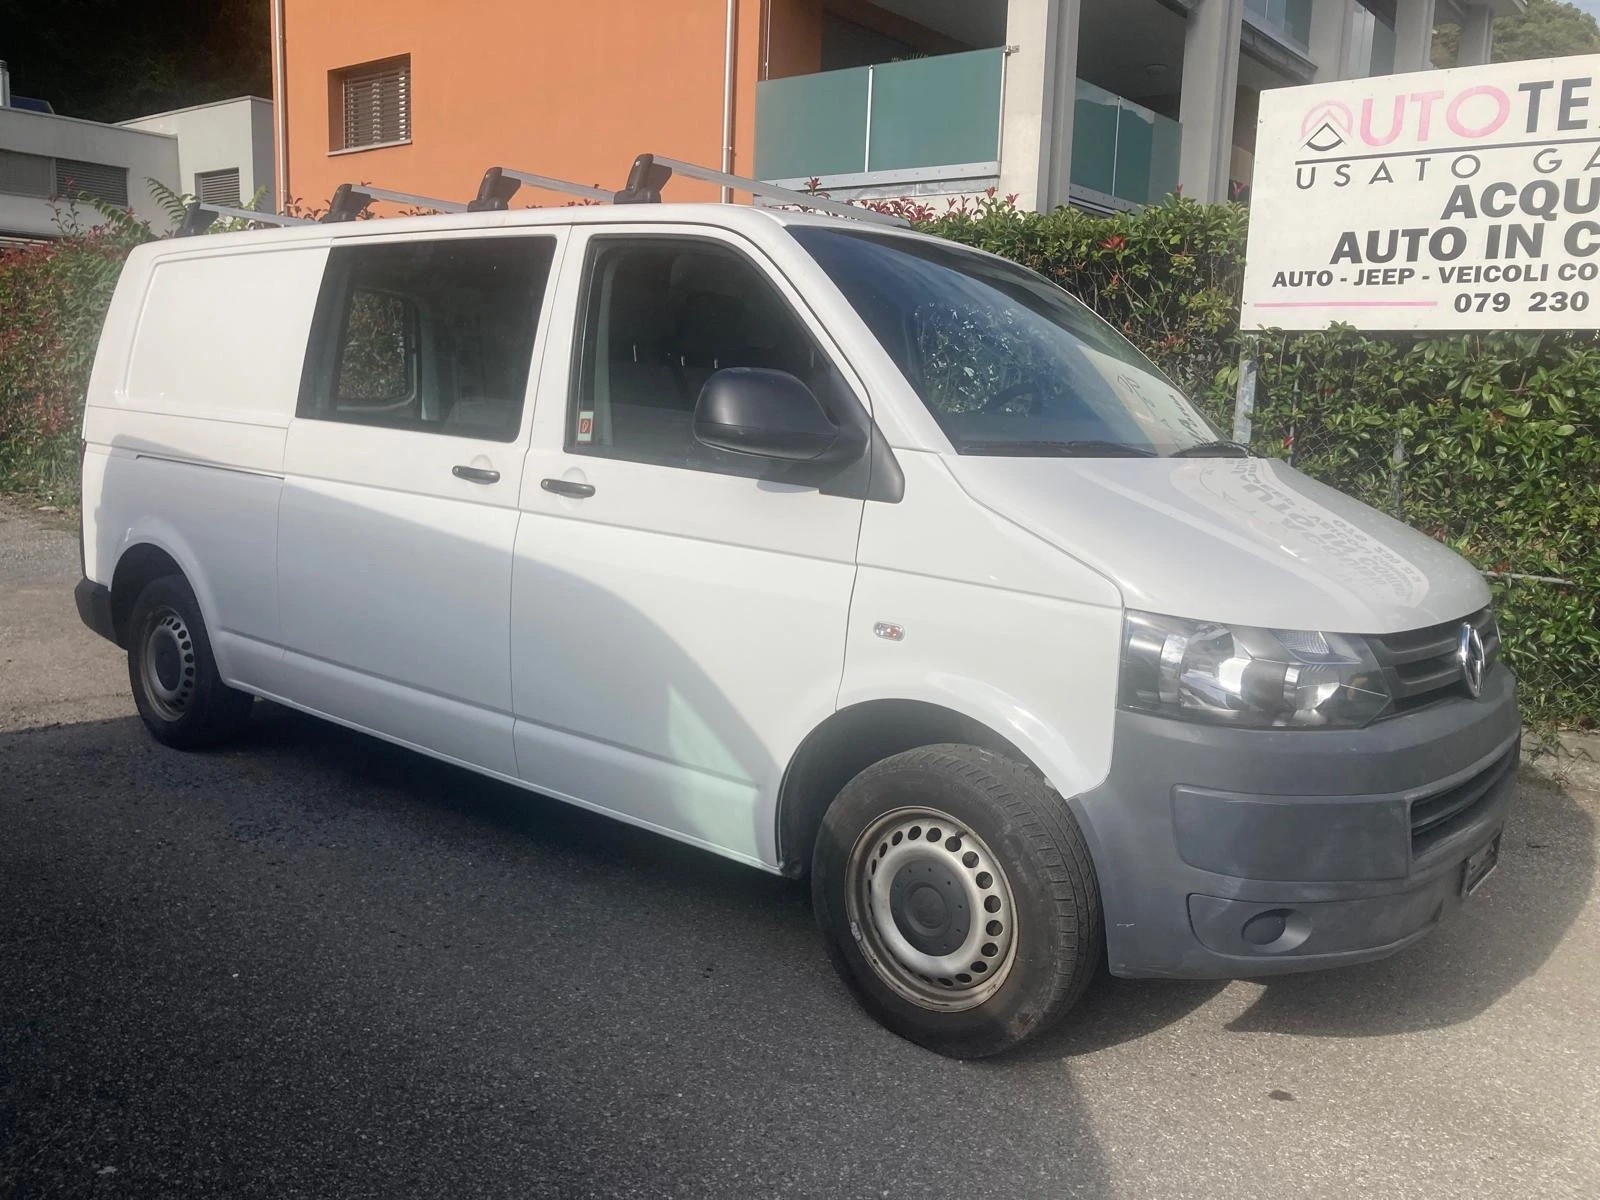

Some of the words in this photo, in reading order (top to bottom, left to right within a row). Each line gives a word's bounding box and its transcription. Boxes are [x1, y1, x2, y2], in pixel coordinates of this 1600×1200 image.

[1300, 76, 1600, 152] AUTOTE
[1295, 153, 1482, 190] USATO
[1439, 176, 1600, 221] ACQU
[1328, 226, 1468, 266] AUTO
[1484, 222, 1546, 260] IN
[1563, 220, 1600, 258] C
[1271, 269, 1334, 288] AUTO
[1352, 267, 1416, 287] JEEP
[1438, 263, 1549, 285] VEICOLI
[1557, 262, 1600, 282] CO
[1453, 291, 1511, 314] 079
[1527, 290, 1590, 313] 230
